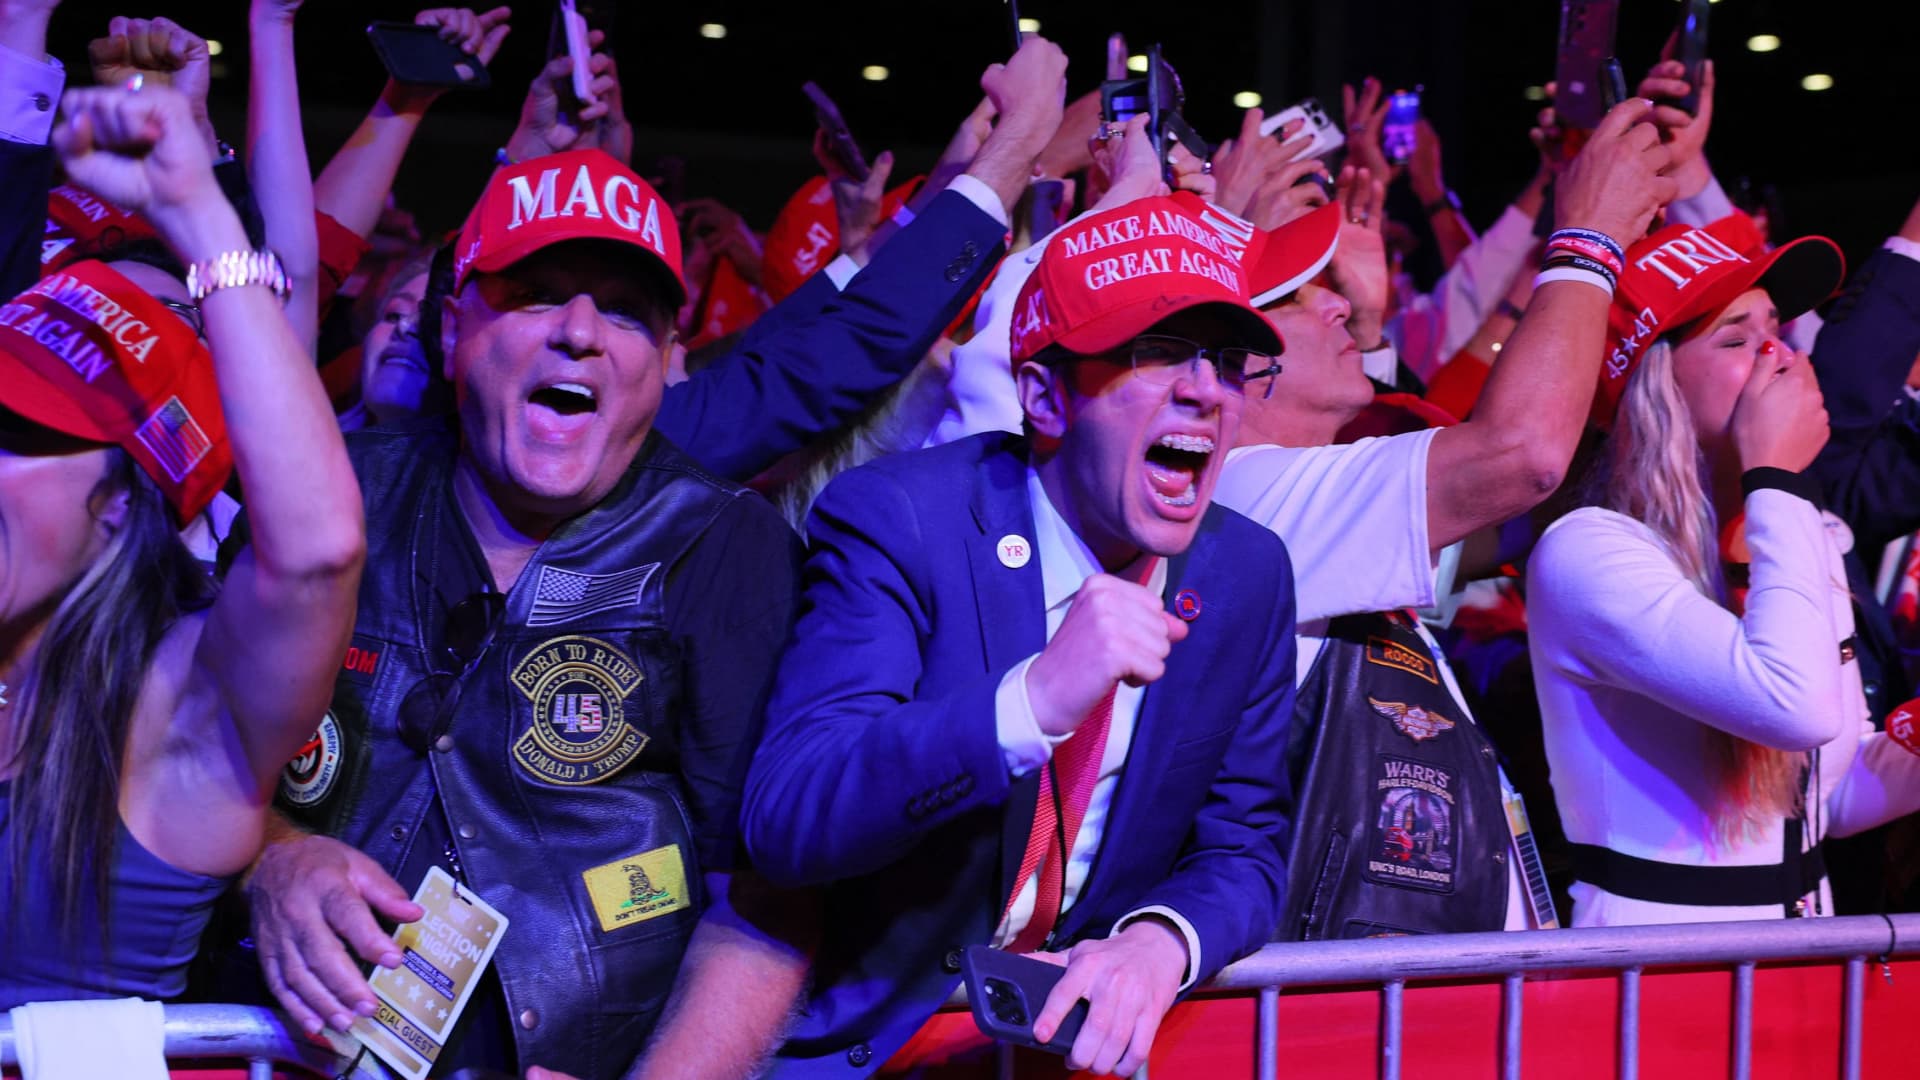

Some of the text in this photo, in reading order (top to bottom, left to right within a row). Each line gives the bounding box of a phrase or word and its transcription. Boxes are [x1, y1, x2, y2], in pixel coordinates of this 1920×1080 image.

[507, 165, 666, 256] MAGA
[1063, 211, 1241, 267] MAKE AMERICA
[1085, 248, 1241, 297] GREAT AGAIN
[33, 273, 160, 363] AMERICA
[13, 312, 114, 384] AGAIN
[1004, 545, 1024, 557] YR
[518, 642, 638, 687] BORN TO RIDE
[552, 693, 603, 733] 45
[519, 733, 640, 780] DONALD J TRUMP
[1384, 761, 1450, 788] WARR'S
[1418, 867, 1450, 883] LONDON
[417, 928, 462, 970] NIGHT
[401, 1026, 435, 1055] GUEST
